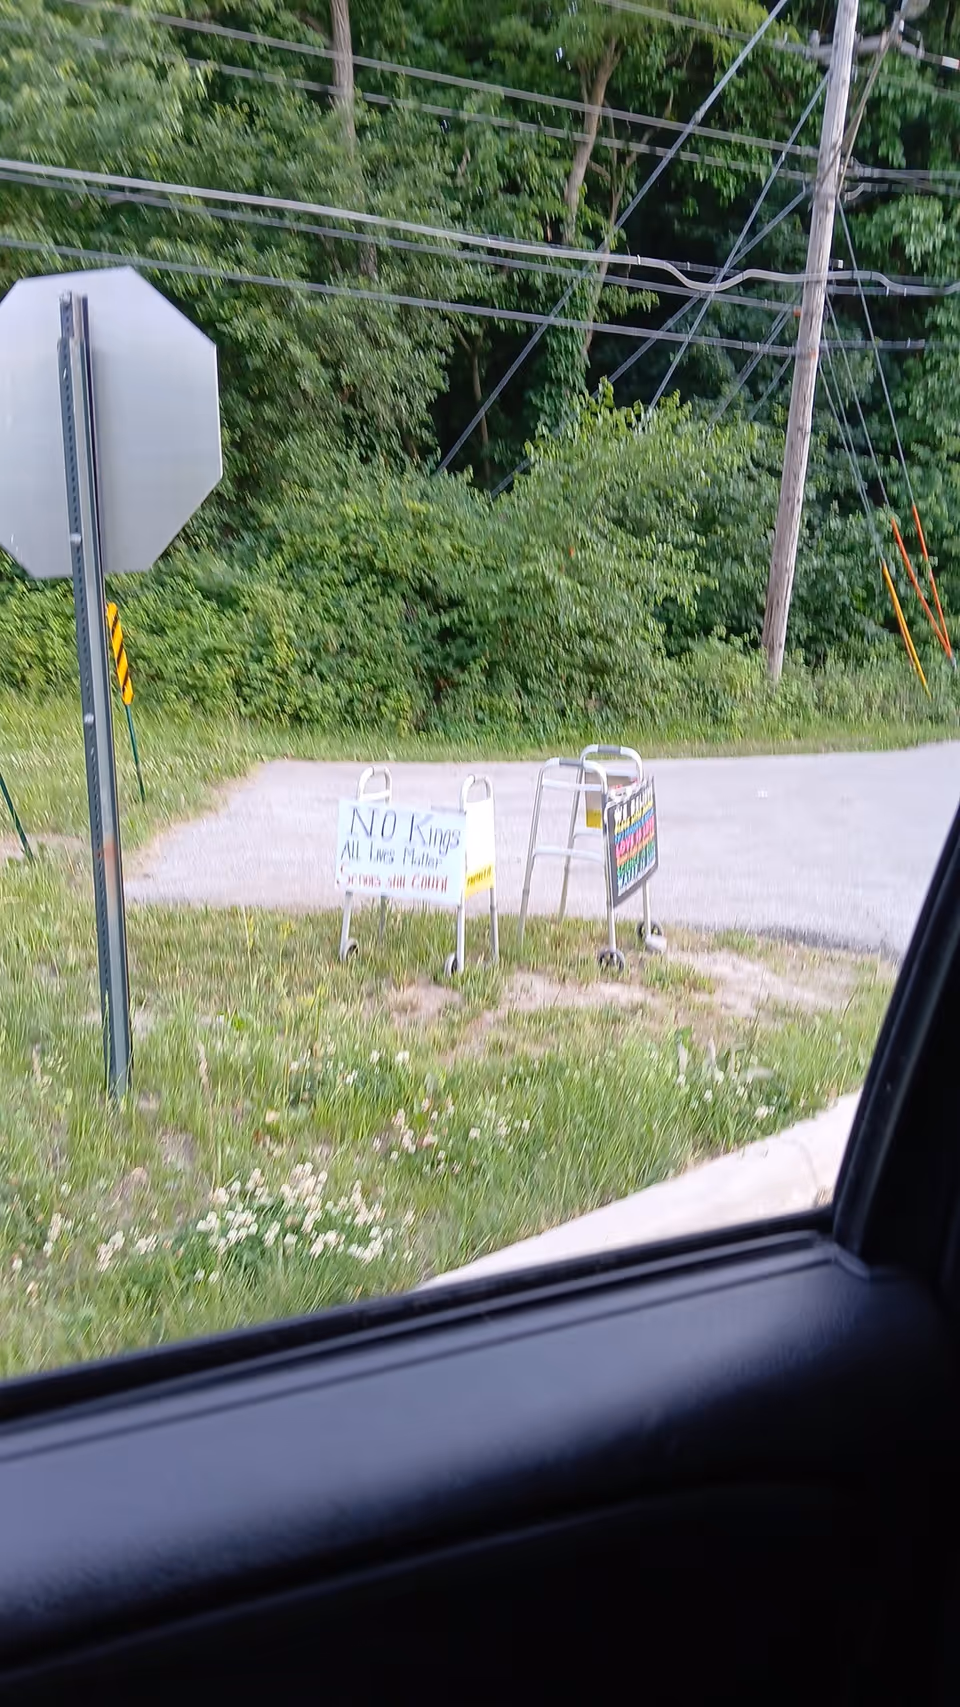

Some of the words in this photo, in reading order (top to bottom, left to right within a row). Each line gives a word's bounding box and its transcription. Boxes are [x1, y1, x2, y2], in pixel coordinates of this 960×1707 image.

[350, 807, 397, 842] NO
[409, 813, 461, 857] Kings
[340, 839, 361, 862] All
[369, 840, 396, 864] Lives
[402, 846, 444, 871] Matter
